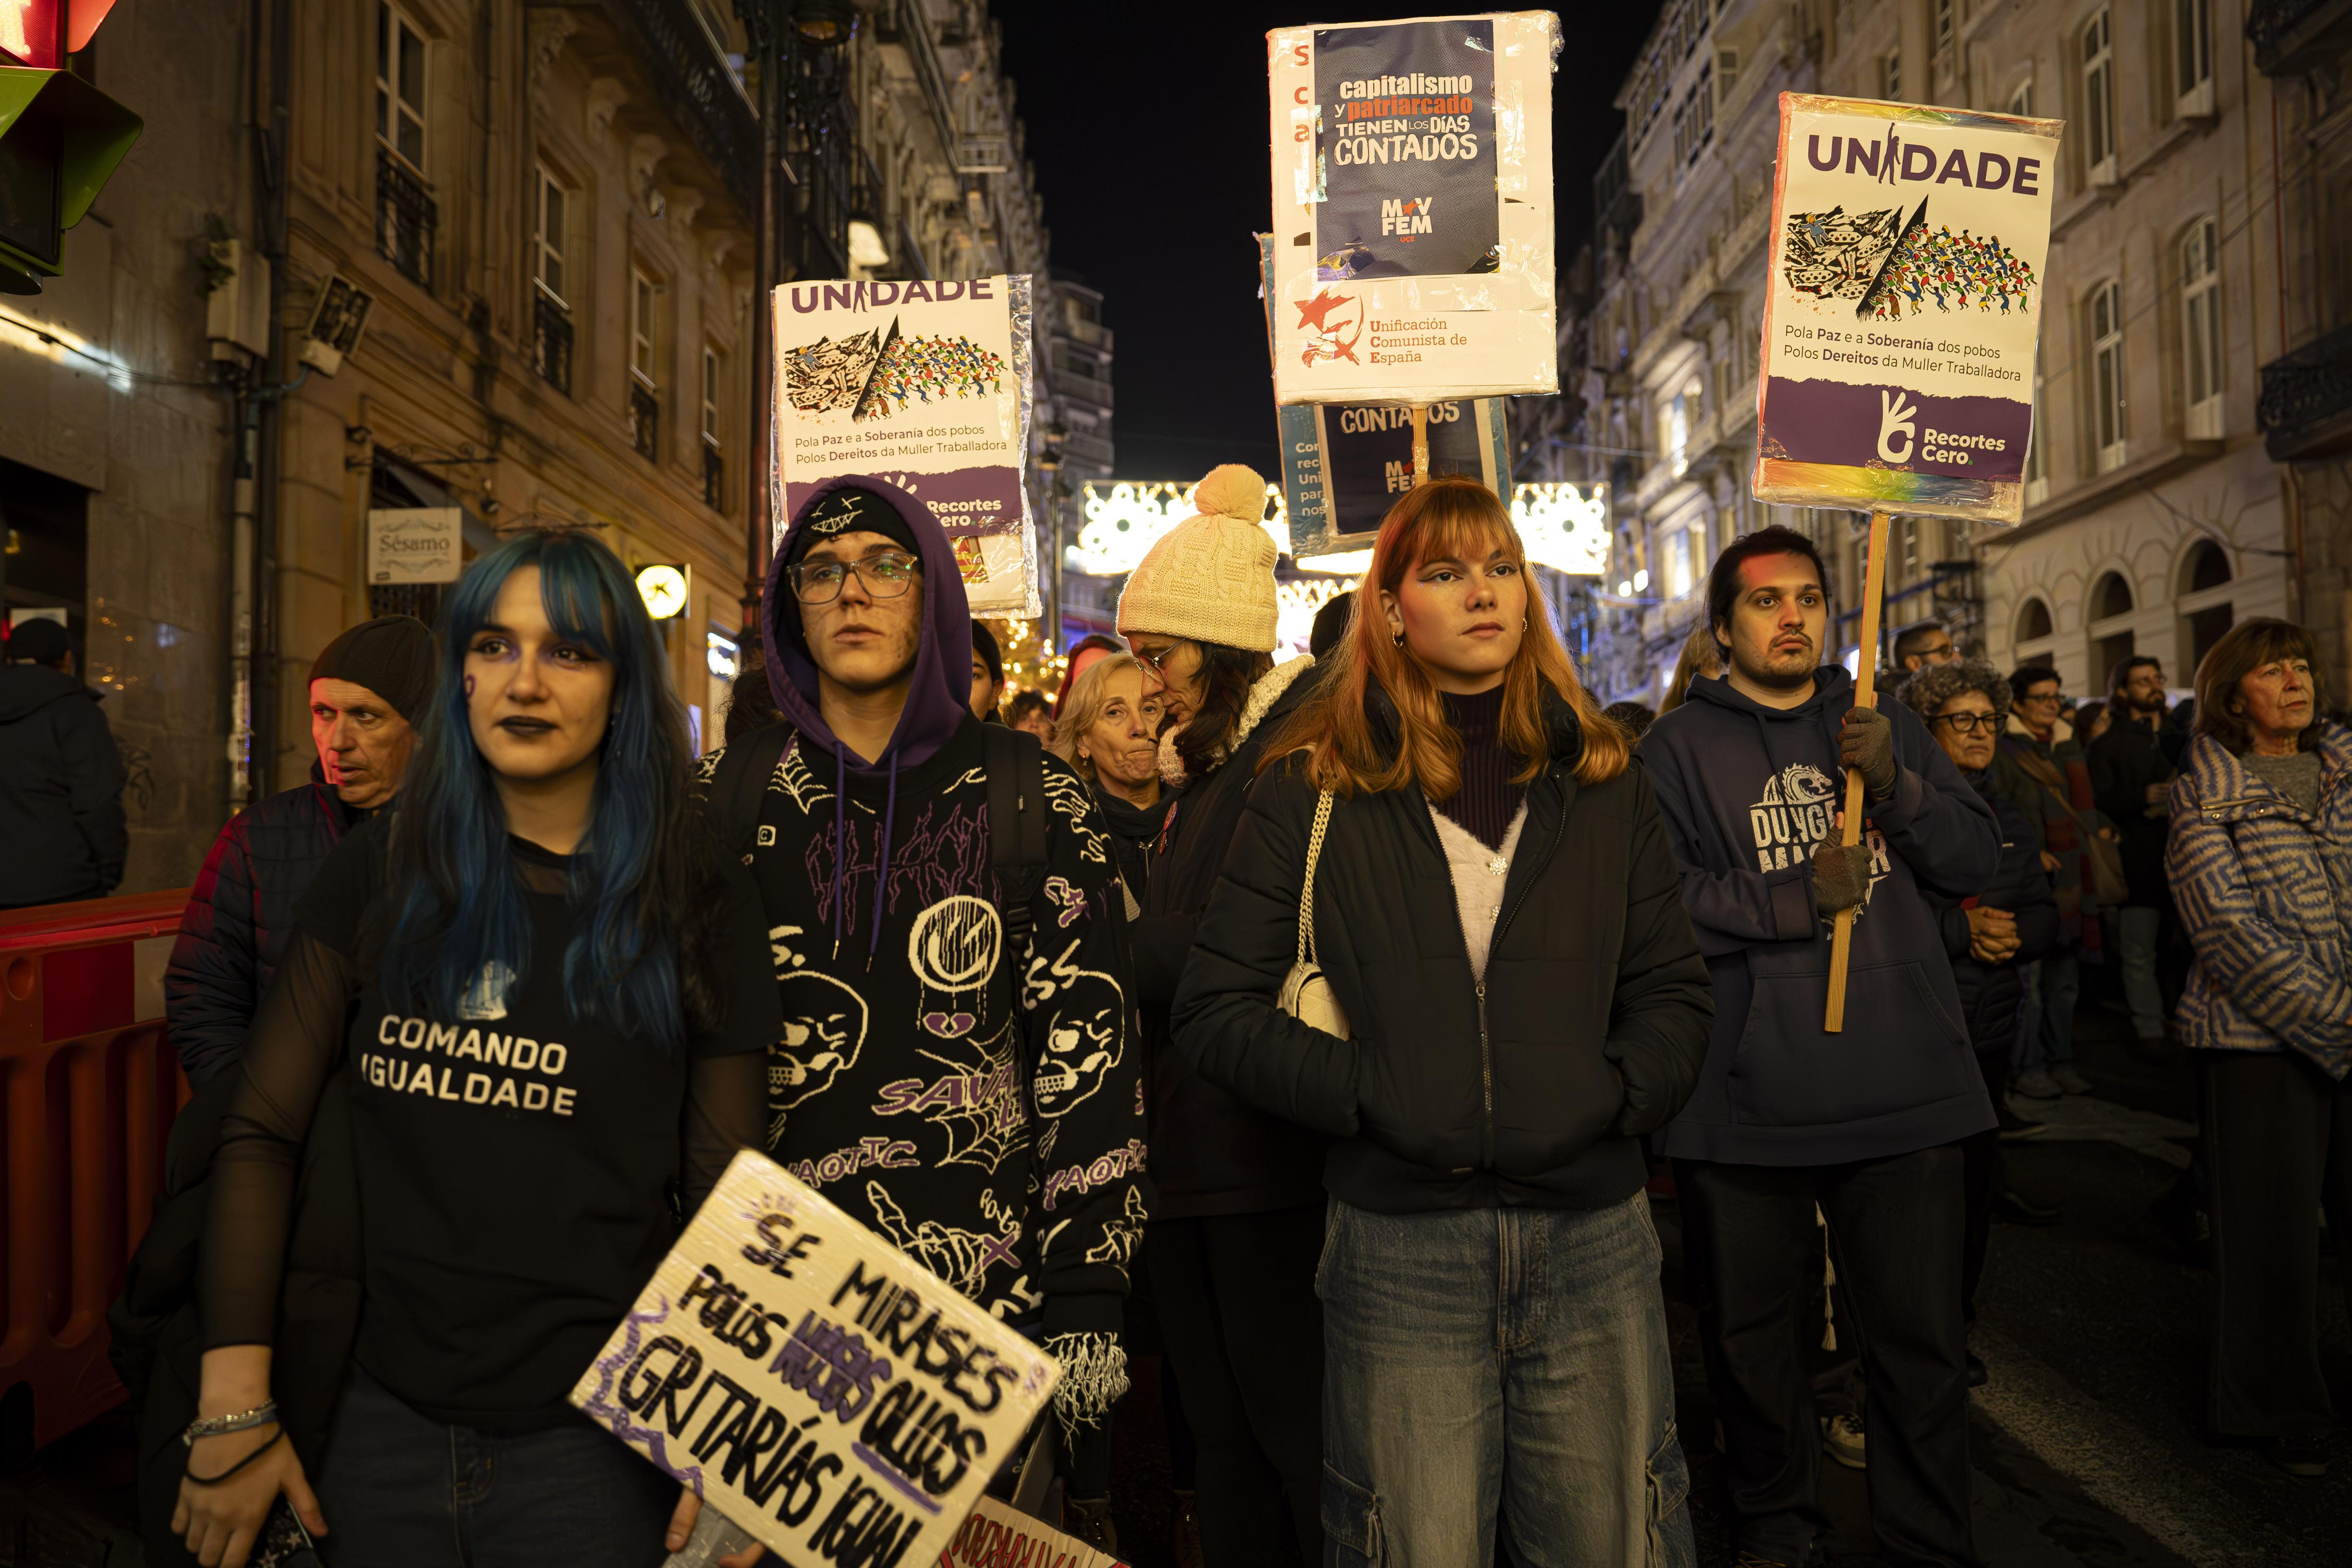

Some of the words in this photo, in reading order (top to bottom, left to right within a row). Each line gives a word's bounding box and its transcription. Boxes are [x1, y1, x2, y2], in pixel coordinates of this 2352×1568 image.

[1340, 73, 1473, 99] capitalismo
[1334, 102, 1345, 118] y
[1347, 95, 1473, 121] patriarcado
[1336, 119, 1407, 137] TIENEN
[1409, 121, 1428, 130] LOS
[1334, 133, 1478, 166] CONTADOS
[1808, 122, 2040, 196] UNIDADE
[1382, 215, 1433, 236] FEM
[1370, 318, 1448, 332] Unificación
[1370, 334, 1446, 348] Comunista
[1450, 333, 1467, 345] de
[1785, 325, 1813, 339] Pola
[1817, 328, 1841, 341] Paz
[1845, 333, 1852, 342] e
[1856, 334, 1863, 344] a
[1867, 333, 1934, 351] Soberanía
[1938, 340, 1961, 354] dos
[1963, 343, 2000, 359] pobos
[1370, 350, 1422, 365] España
[1784, 345, 1818, 359] Polos
[1822, 349, 1878, 365] Dereitos
[1882, 354, 1898, 367] da
[1902, 357, 1943, 372] Muller
[1947, 361, 2021, 381] Traballadora
[1341, 401, 1460, 434] CONTAOS
[796, 438, 819, 448] Pola
[823, 436, 842, 445] Paz
[846, 435, 852, 443] e
[856, 434, 862, 442] a
[865, 428, 923, 441] Soberanía
[926, 426, 947, 437] dos
[950, 425, 985, 438] pobos
[1924, 428, 2006, 451] Recortes
[796, 453, 827, 464] Polos
[829, 448, 877, 462] Dereitos
[881, 447, 894, 457] da
[898, 444, 933, 455] Muller
[936, 440, 1007, 452] Traballadora
[926, 499, 1002, 513] Recortes
[934, 514, 976, 528] ero.
[378, 1014, 567, 1075] COMANDO
[361, 1053, 577, 1116] IGUALDADE
[740, 1213, 823, 1280] SE
[829, 1259, 1019, 1417] MIRASES
[677, 1262, 789, 1360] POLOS
[858, 1379, 987, 1496] OLLOS
[618, 1335, 844, 1529] GRITARÍAS
